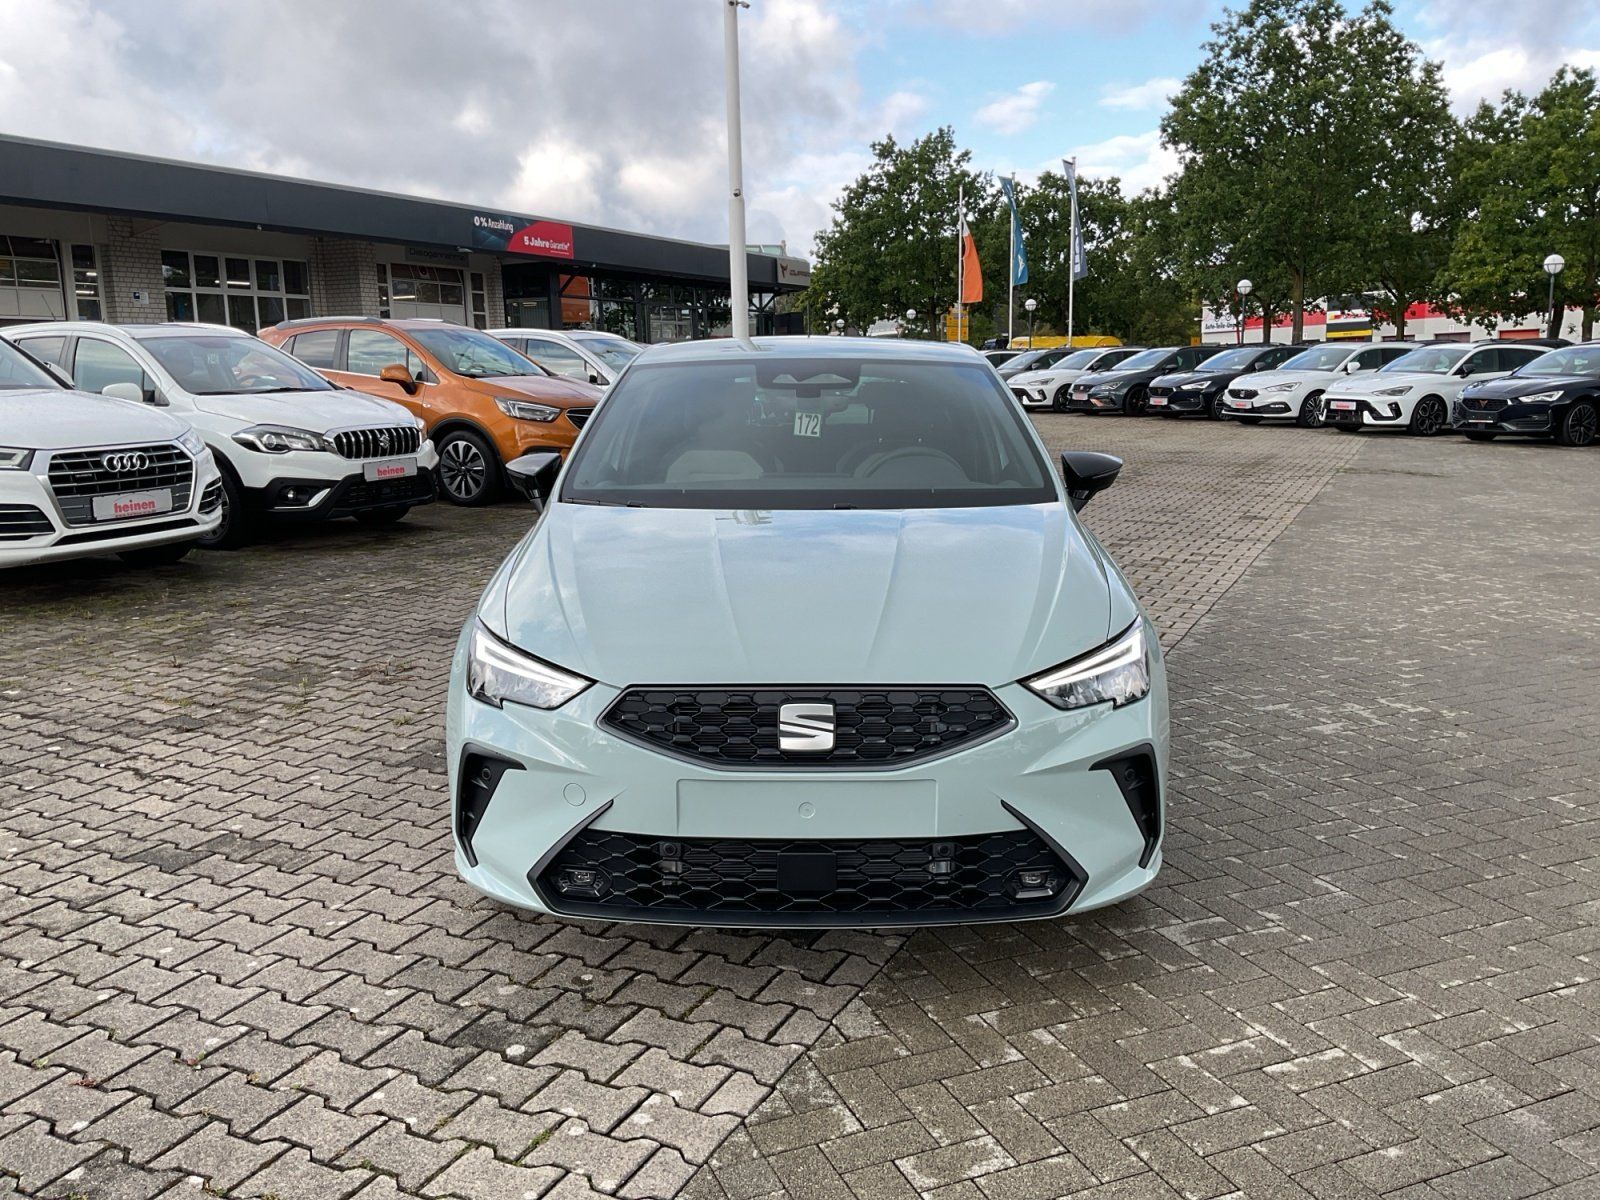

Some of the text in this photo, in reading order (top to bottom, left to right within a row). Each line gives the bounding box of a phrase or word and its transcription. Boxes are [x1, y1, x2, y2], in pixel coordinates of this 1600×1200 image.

[488, 218, 514, 233] Anzahlung
[524, 236, 530, 245] 5
[530, 237, 549, 248] Jahre
[797, 414, 819, 435] 172
[377, 465, 405, 477] heinen
[114, 500, 155, 513] heinen
